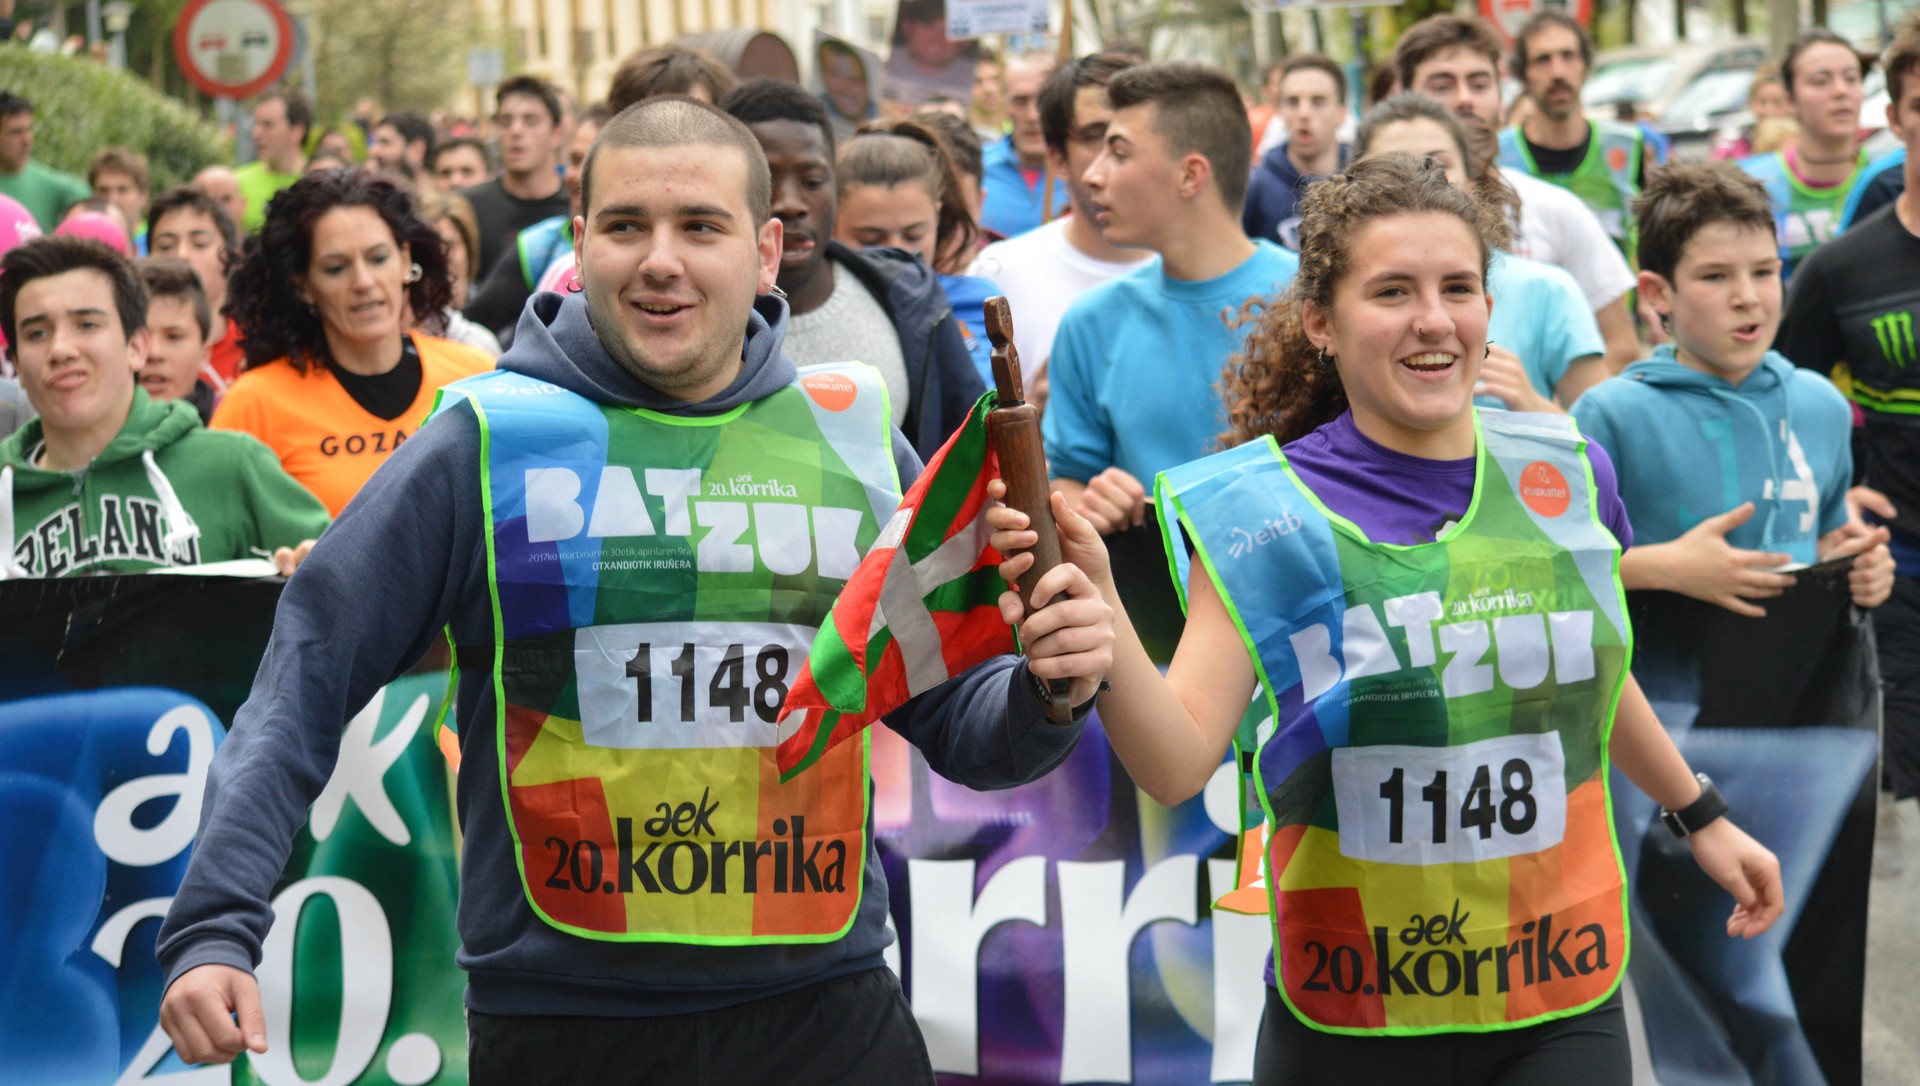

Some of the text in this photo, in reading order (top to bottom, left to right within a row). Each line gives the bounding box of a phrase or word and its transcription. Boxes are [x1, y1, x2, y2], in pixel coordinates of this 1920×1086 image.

[807, 383, 853, 393] euskaltel
[320, 429, 419, 456] GOZA
[736, 472, 753, 483] aek
[1523, 487, 1566, 498] euskaltel
[525, 466, 702, 543] BAT
[1254, 511, 1303, 546] eitb
[528, 546, 692, 563] 2017ko martxoaren 30etik apirilaren 9ra
[592, 558, 692, 571] OTXANDIOTIK IRUÑERA
[695, 502, 864, 580] ZUK
[1289, 591, 1445, 704] BAT
[1438, 610, 1596, 698] ZUK
[625, 642, 790, 723] 1148
[94, 687, 429, 867] ak
[1380, 758, 1537, 844] 1148
[644, 786, 720, 838] aek
[1400, 897, 1470, 947] aek
